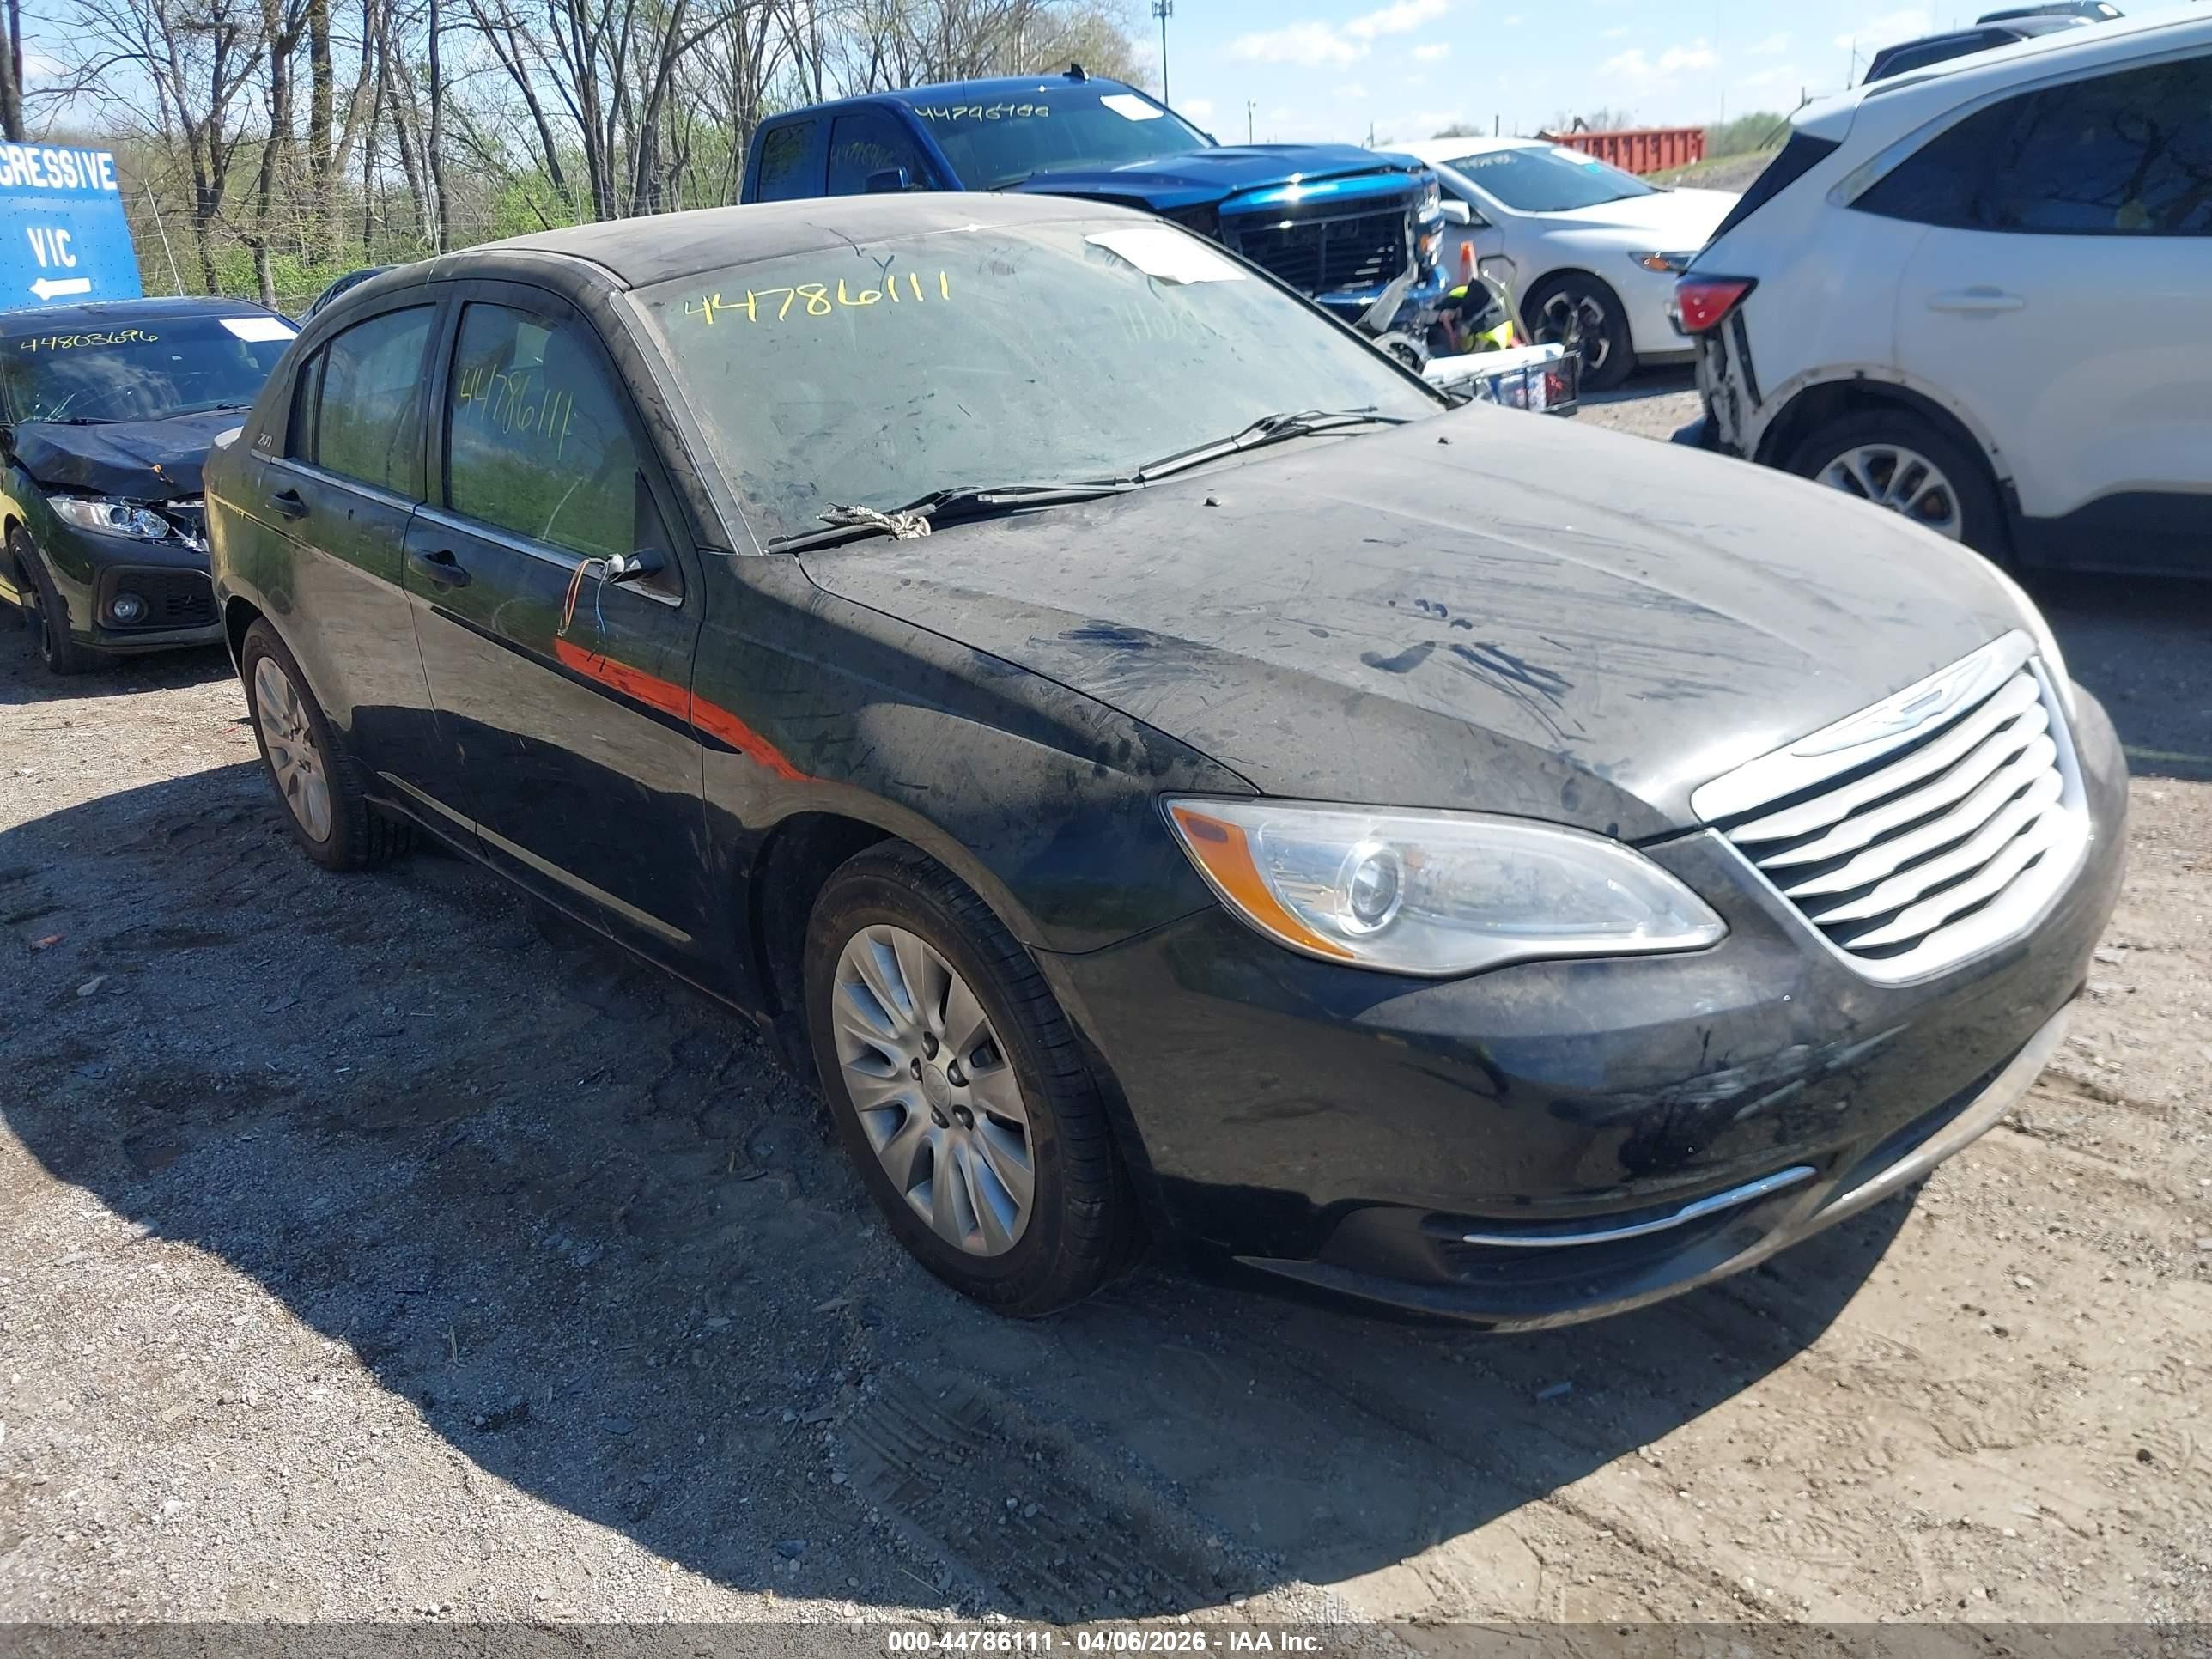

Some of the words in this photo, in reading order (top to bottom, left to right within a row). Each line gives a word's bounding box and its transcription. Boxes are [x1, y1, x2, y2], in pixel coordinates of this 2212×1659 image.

[27, 228, 76, 268] VIC
[684, 270, 950, 325] 44786111
[21, 329, 159, 352] 44803696
[460, 363, 574, 460] 44786111
